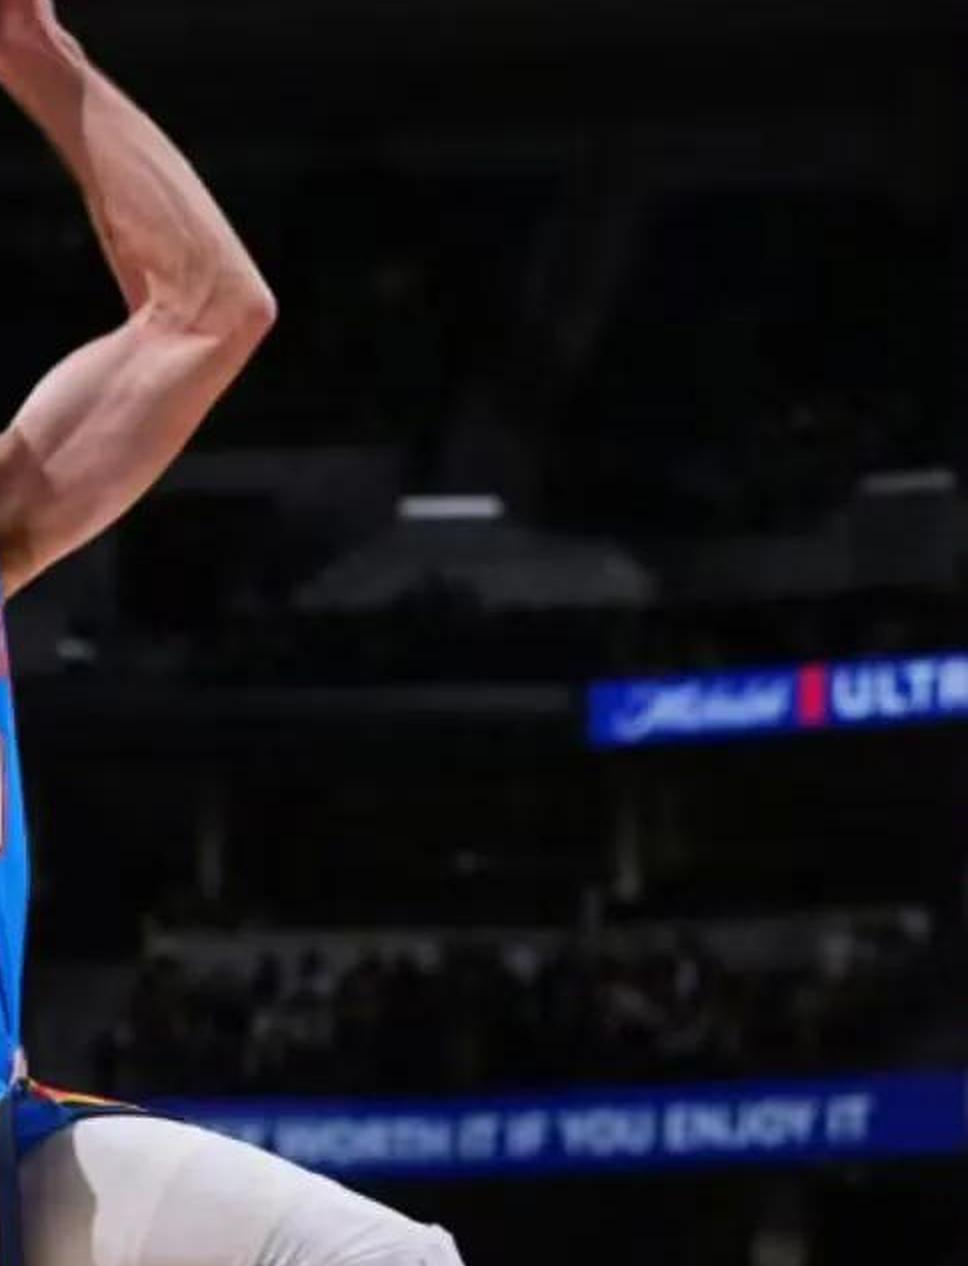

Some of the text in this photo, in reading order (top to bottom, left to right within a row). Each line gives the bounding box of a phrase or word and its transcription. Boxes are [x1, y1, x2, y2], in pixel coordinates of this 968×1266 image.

[456, 1111, 498, 1160] IT
[504, 1110, 549, 1158] IF
[560, 1106, 654, 1156] YOU
[662, 1097, 815, 1154] ENJOY
[825, 1093, 873, 1144] IT
